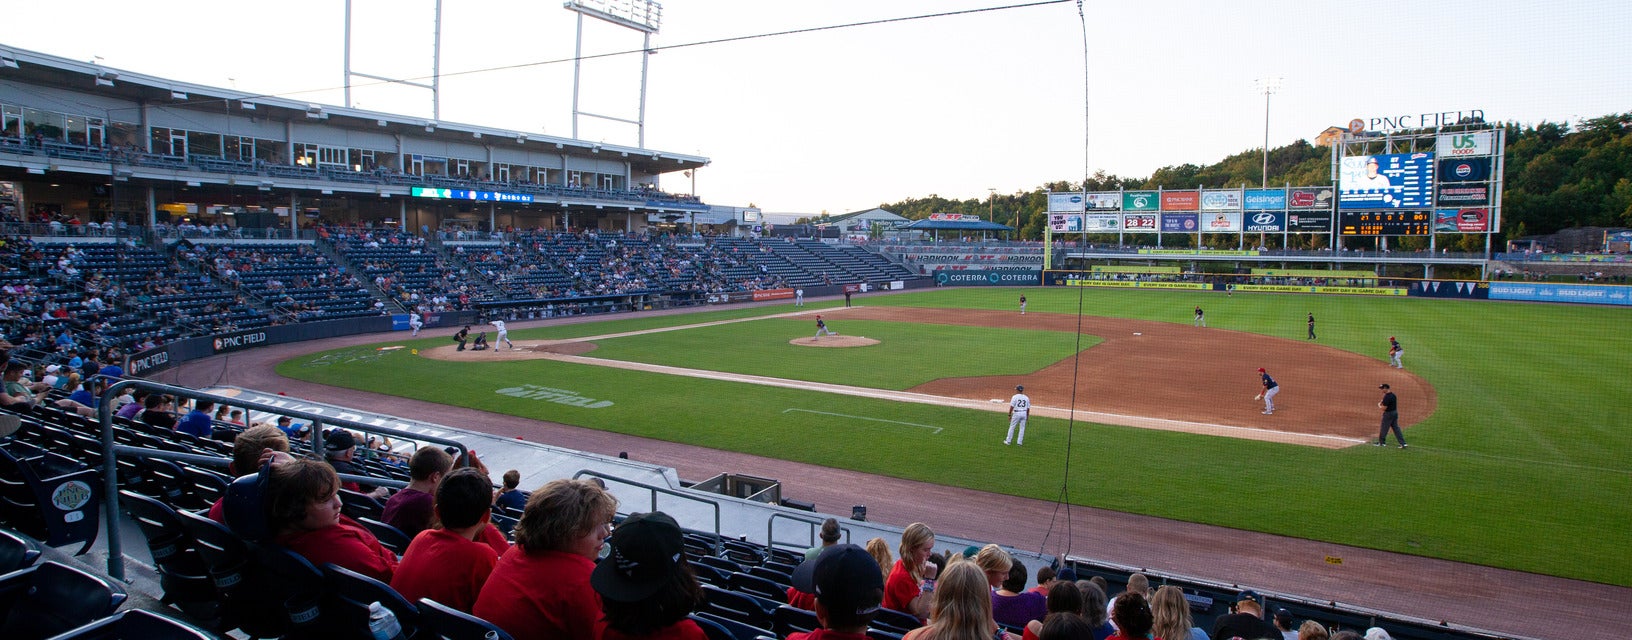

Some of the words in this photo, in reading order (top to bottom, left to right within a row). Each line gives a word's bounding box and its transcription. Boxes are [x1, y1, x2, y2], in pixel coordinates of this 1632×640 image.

[1370, 115, 1412, 131] PNC
[1420, 109, 1484, 127] FIELD
[1246, 195, 1284, 204] Geisinger
[1126, 219, 1139, 227] 28
[1141, 219, 1154, 227] 22
[223, 336, 242, 348] PNC
[243, 332, 266, 345] FIELD
[136, 356, 151, 372] PNC
[151, 351, 168, 366] FIELD
[1017, 399, 1026, 408] 23
